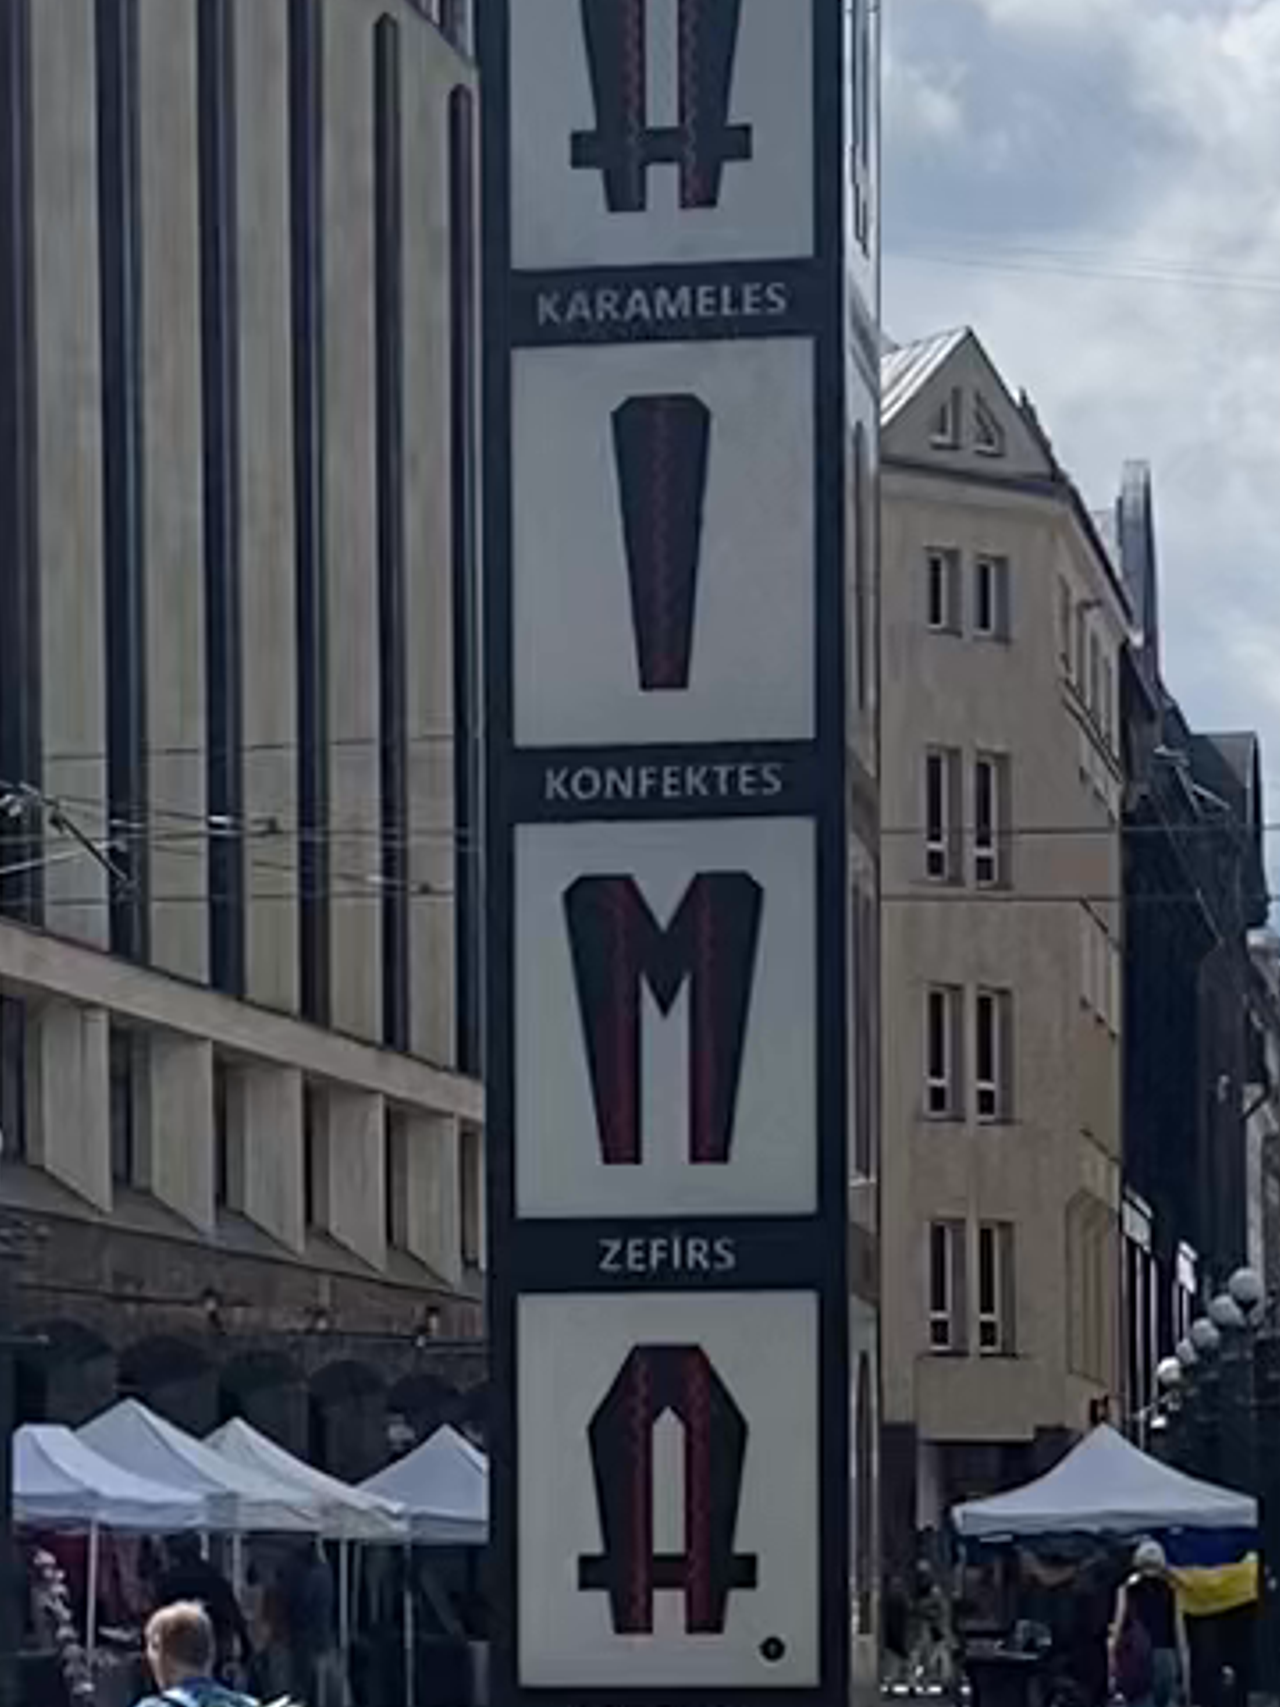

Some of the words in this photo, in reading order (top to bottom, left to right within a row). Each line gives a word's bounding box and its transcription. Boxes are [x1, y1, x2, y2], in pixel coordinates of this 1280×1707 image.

[536, 282, 788, 327] KARAMELES
[544, 762, 784, 801] KONFEKTES
[561, 869, 766, 1166] M
[577, 1342, 759, 1635] A
